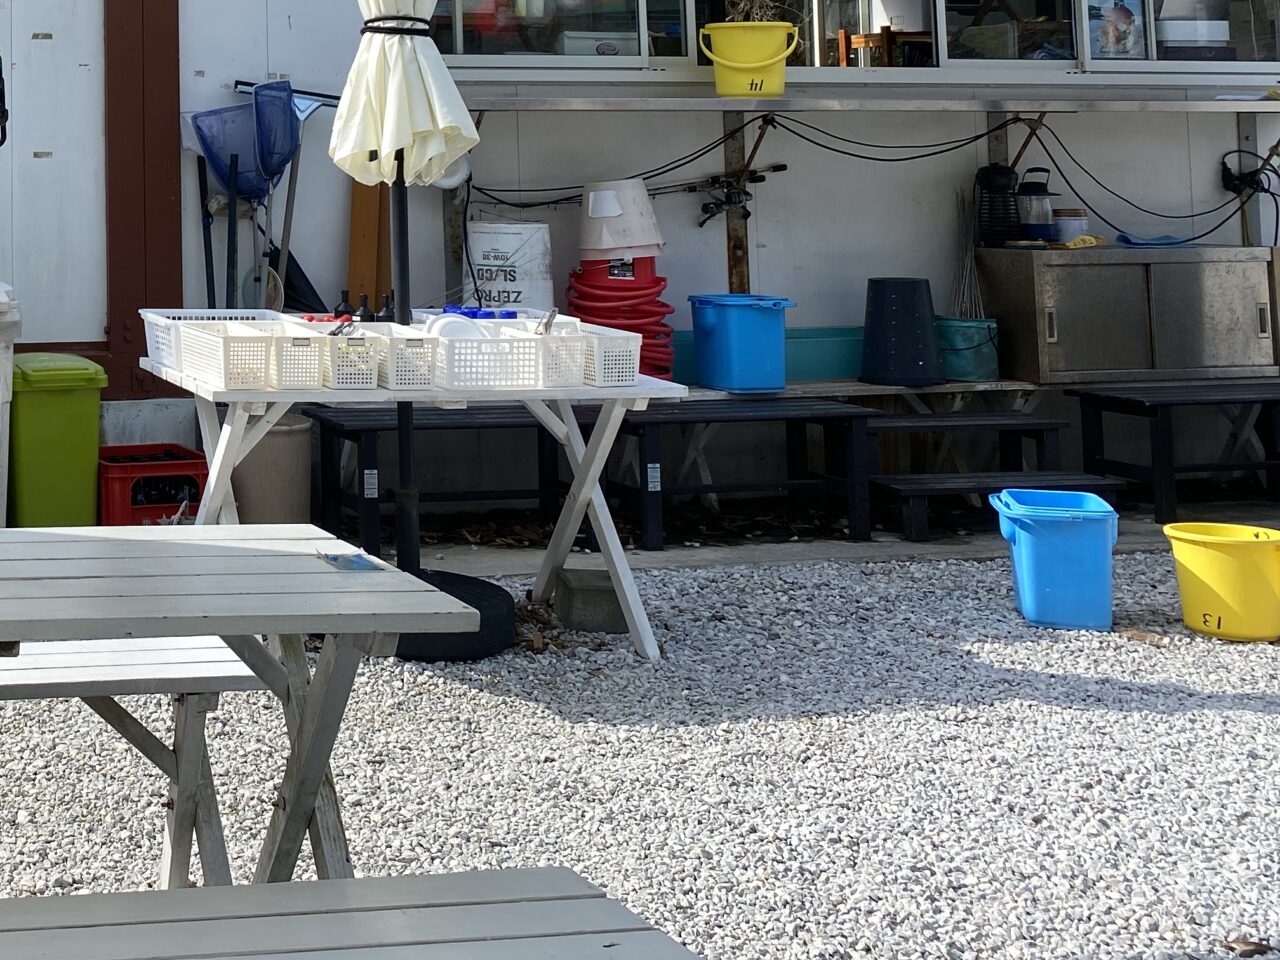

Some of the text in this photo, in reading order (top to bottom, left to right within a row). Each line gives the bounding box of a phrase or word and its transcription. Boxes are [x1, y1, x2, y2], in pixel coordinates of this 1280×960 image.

[482, 253, 510, 261] 10W-30
[476, 268, 517, 283] SL/CD
[472, 290, 523, 303] ZEPRO
